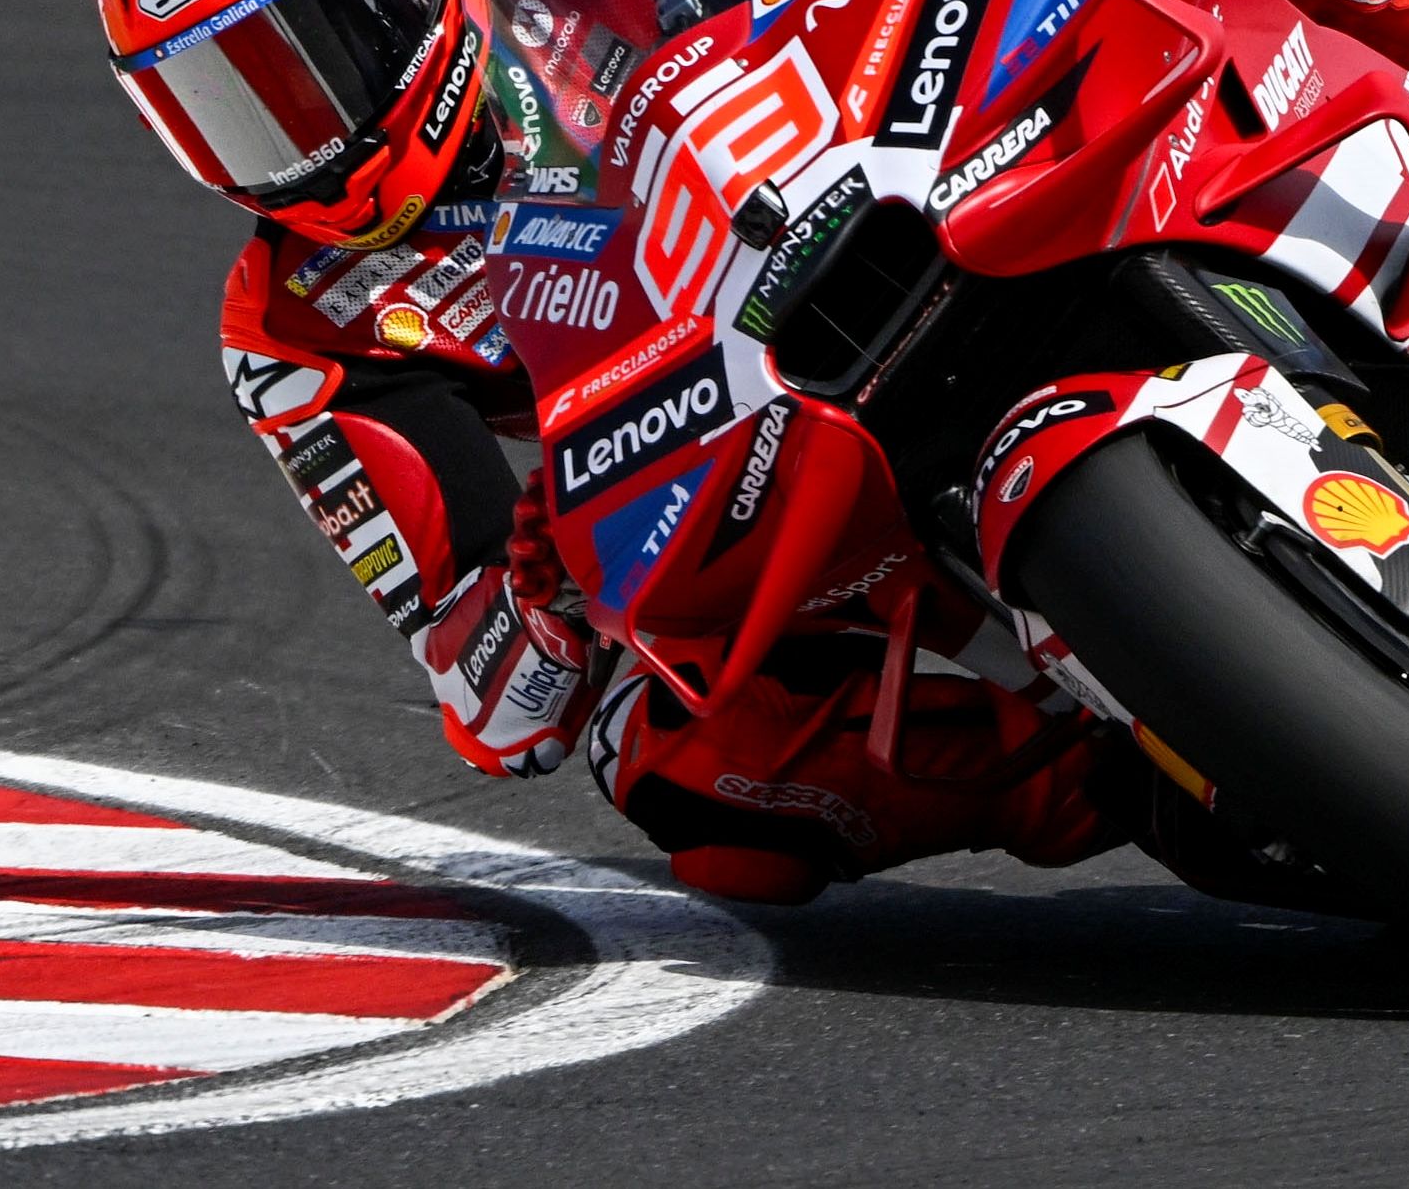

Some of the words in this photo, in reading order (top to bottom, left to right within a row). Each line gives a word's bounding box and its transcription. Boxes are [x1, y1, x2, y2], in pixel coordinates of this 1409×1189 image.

[166, 26, 212, 55] Estrella
[394, 32, 437, 90] VERTICAL
[544, 10, 581, 76] motorola
[593, 46, 626, 92] Lenovo
[1253, 20, 1314, 132] DUCATI
[424, 31, 477, 141] Lenovo
[508, 66, 541, 175] Lenovo
[610, 35, 716, 168] VARGROUP
[268, 137, 345, 186] Insta360
[929, 107, 1053, 212] CARRERA
[1168, 98, 1204, 181] Audi
[528, 166, 580, 193] WRS
[639, 41, 836, 322] 93
[434, 205, 486, 226] TIM
[513, 215, 608, 252] ADVANCE
[758, 176, 865, 299] MONSTER
[329, 248, 406, 315] EATALY
[432, 243, 483, 290] riello
[519, 264, 620, 331] riello
[581, 317, 698, 399] FRECCIAROSSA
[562, 377, 718, 493] Lenovo
[730, 402, 790, 521] CARRERA
[641, 481, 691, 556] TIM
[826, 552, 909, 600] Sport
[463, 611, 511, 686] Lenovo
[506, 659, 568, 712] Unipo
